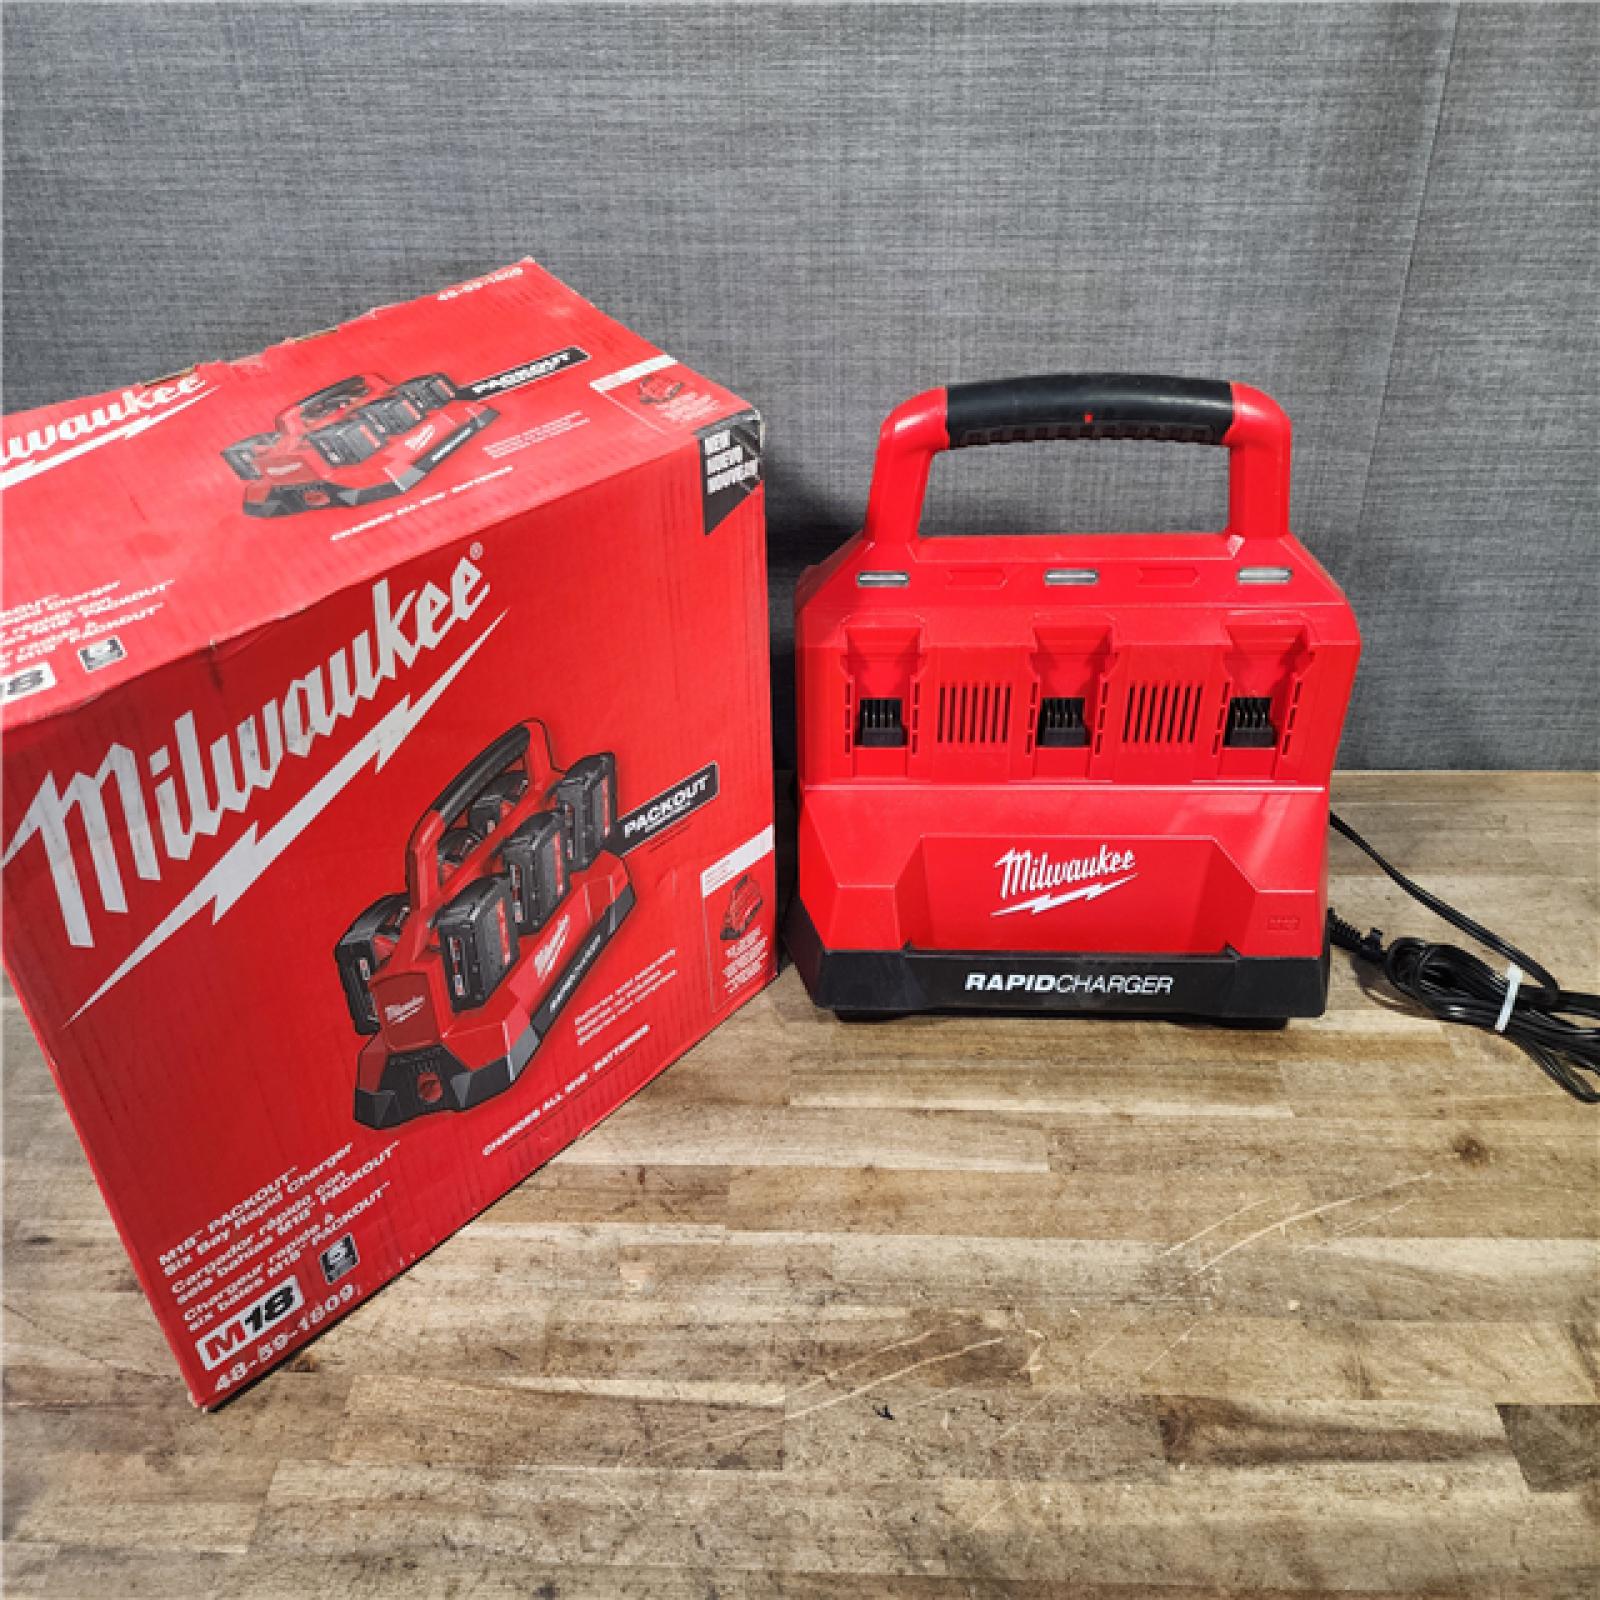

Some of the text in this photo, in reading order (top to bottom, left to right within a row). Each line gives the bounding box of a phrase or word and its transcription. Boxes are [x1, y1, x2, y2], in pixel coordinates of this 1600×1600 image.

[2, 555, 491, 948] Milwaukee
[624, 774, 709, 838] PACKOUT
[994, 844, 1136, 899] Milwaukee
[965, 971, 1175, 995] RAPIDCHARGER
[196, 1229, 229, 1256] Bay
[235, 1191, 282, 1230] Rapid
[287, 1142, 352, 1193] Charger
[172, 1233, 255, 1293] Cargador
[183, 1262, 264, 1321] Chargeur
[203, 1284, 296, 1367] M18
[215, 1283, 355, 1393] 48-59-1609
